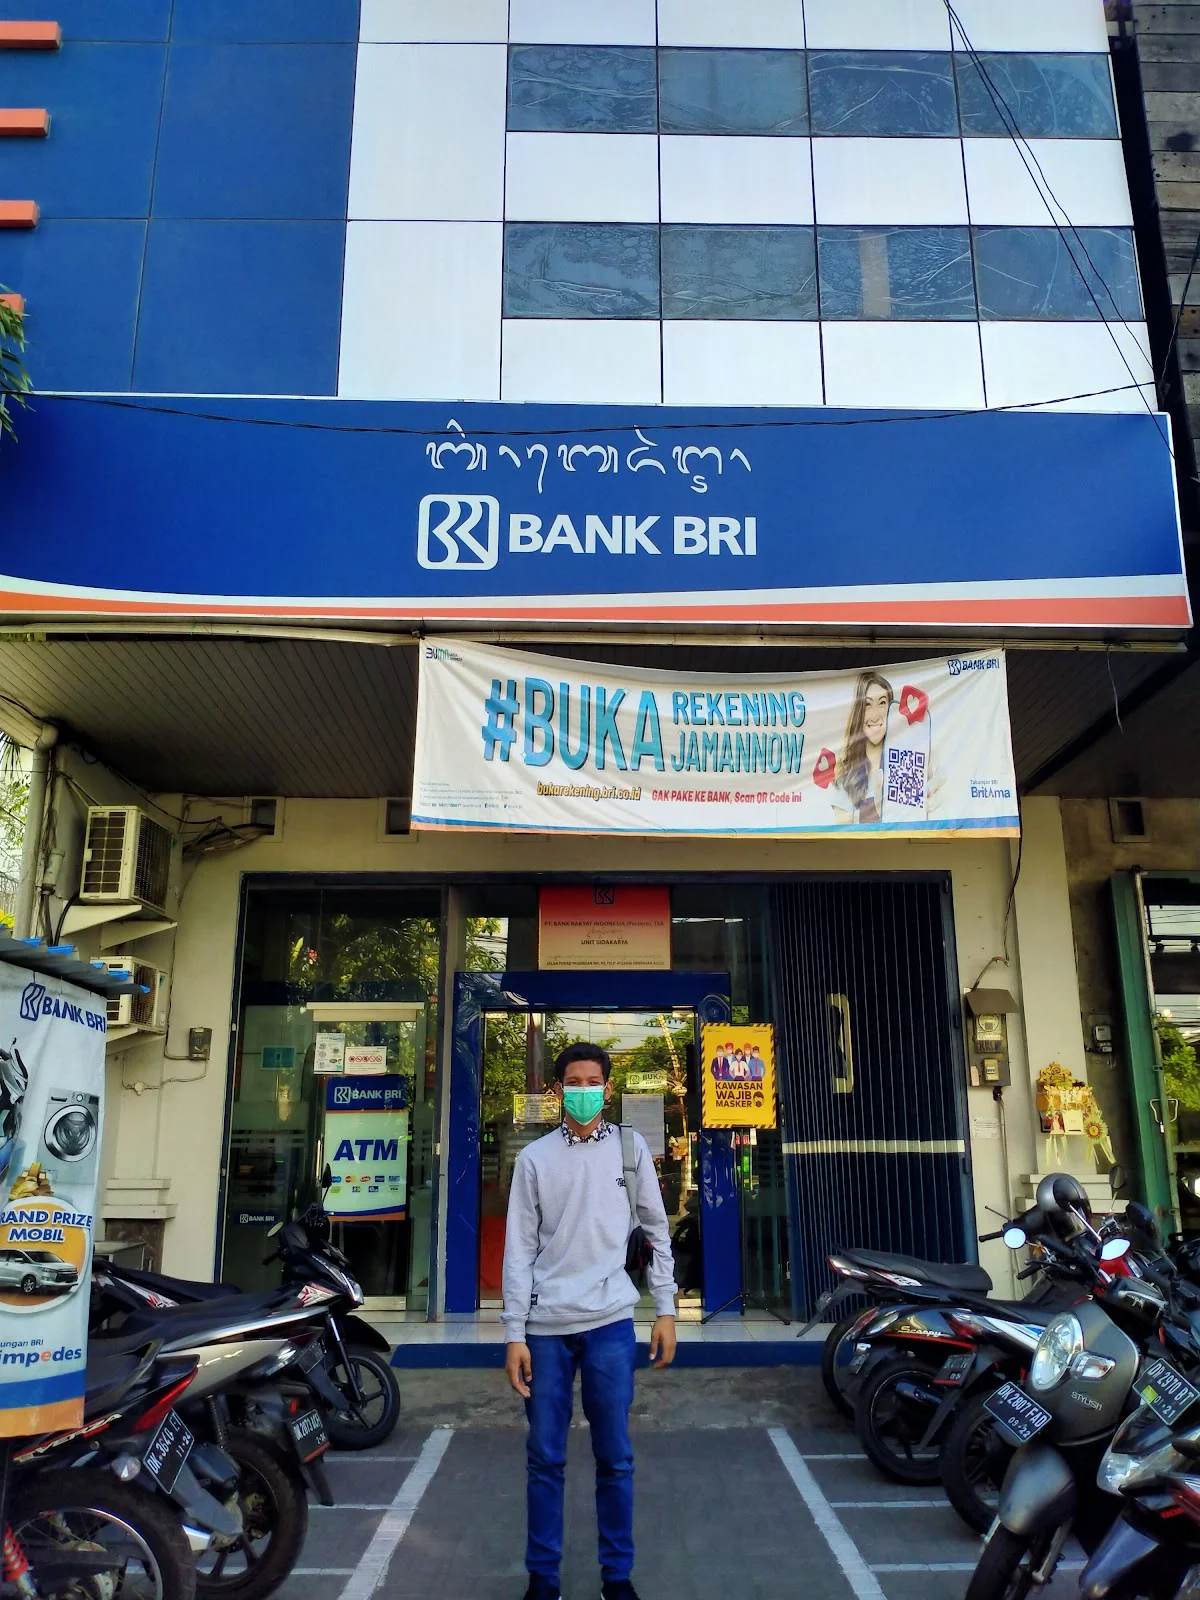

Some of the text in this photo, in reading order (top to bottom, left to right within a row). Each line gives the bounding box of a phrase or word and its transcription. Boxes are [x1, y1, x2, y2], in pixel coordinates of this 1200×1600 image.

[509, 514, 757, 555] BANK BRI
[962, 658, 1000, 671] BANK BRI
[672, 690, 807, 727] REKENING
[482, 677, 665, 772] #BUKA
[671, 731, 805, 772] JAMANNOW
[537, 781, 642, 801] bukarekening.bri.co.id
[652, 790, 802, 804] GAK PAKE KE BANK, Scan QR Code ini
[971, 786, 1011, 798] BritAma
[42, 996, 106, 1034] BANK BRI
[352, 1089, 402, 1099] BANK BRI
[715, 1081, 763, 1091] KAWASAN
[716, 1090, 752, 1100] WAJIB
[716, 1100, 752, 1108] MASKER
[333, 1139, 399, 1161] ATM
[53, 1211, 93, 1227] PRIZE
[9, 1228, 65, 1241] MOBIL
[897, 1325, 945, 1338] Scoopy
[0, 1339, 44, 1349] ungan BRI
[1157, 1371, 1182, 1395] 2970
[1174, 1387, 1195, 1406] BT
[998, 1385, 1048, 1428] DK 2807 FAD
[1071, 1391, 1103, 1411] STYLISH
[147, 1451, 162, 1475] DK
